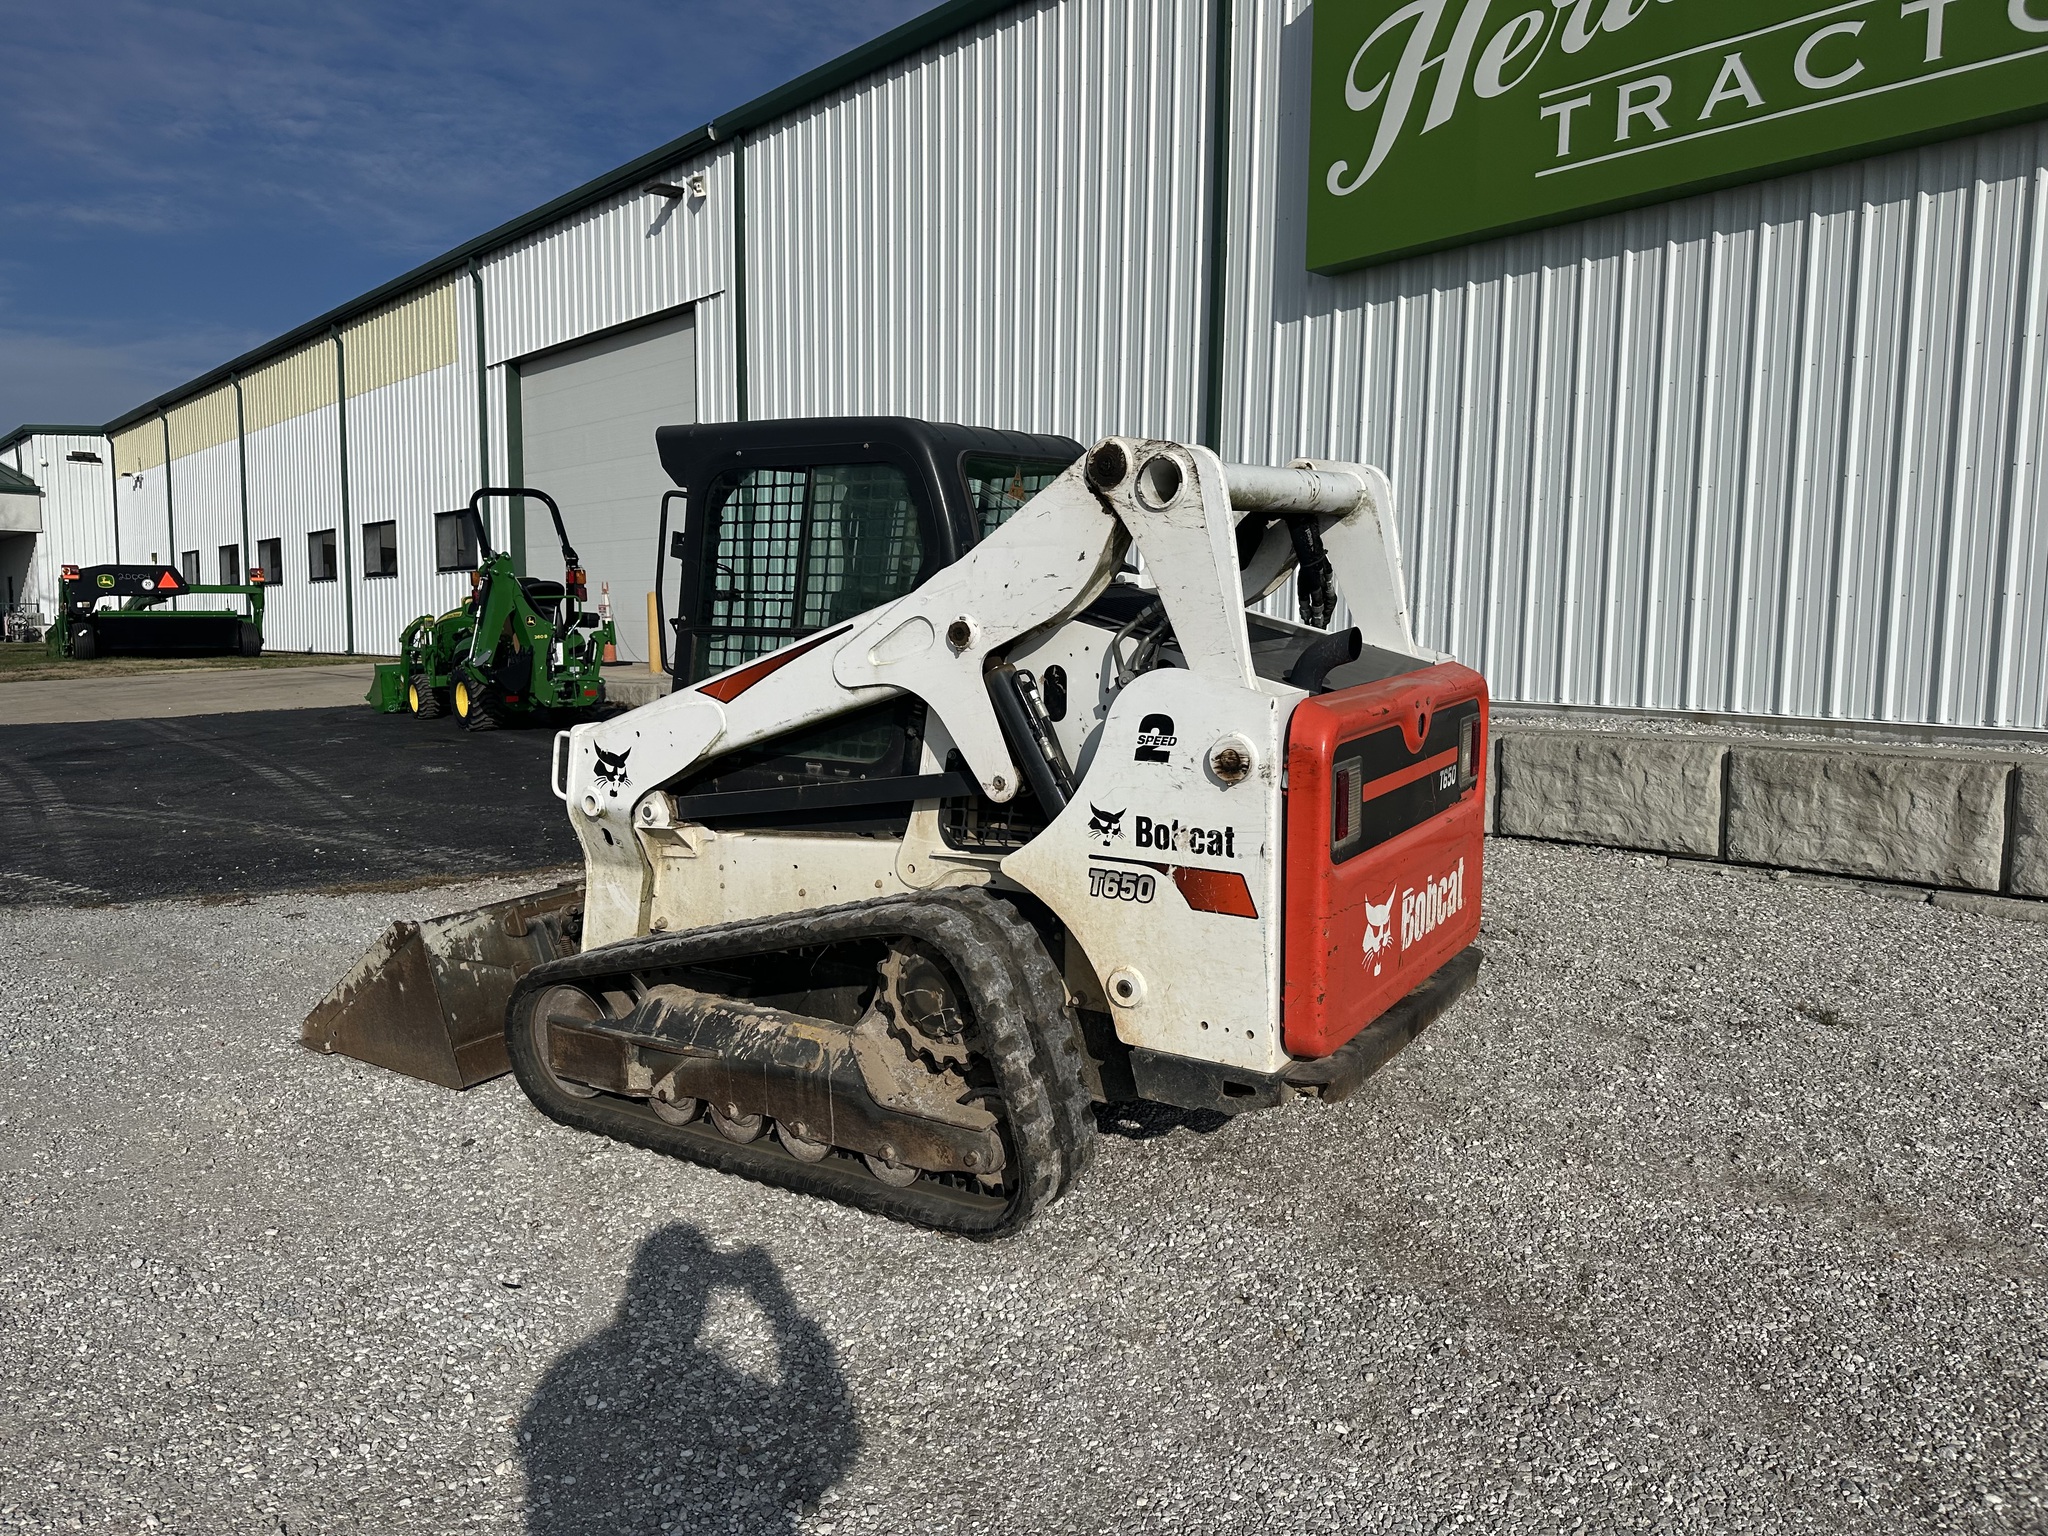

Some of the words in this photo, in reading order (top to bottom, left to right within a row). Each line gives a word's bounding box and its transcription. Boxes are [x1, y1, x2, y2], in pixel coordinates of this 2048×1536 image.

[1326, 0, 1674, 197] Her
[1540, 0, 2048, 158] TRACT
[1134, 713, 1175, 763] 2
[1137, 735, 1178, 747] SPEED
[1439, 764, 1457, 791] T650
[1089, 868, 1156, 903] T650
[1401, 856, 1465, 951] Bobcat
